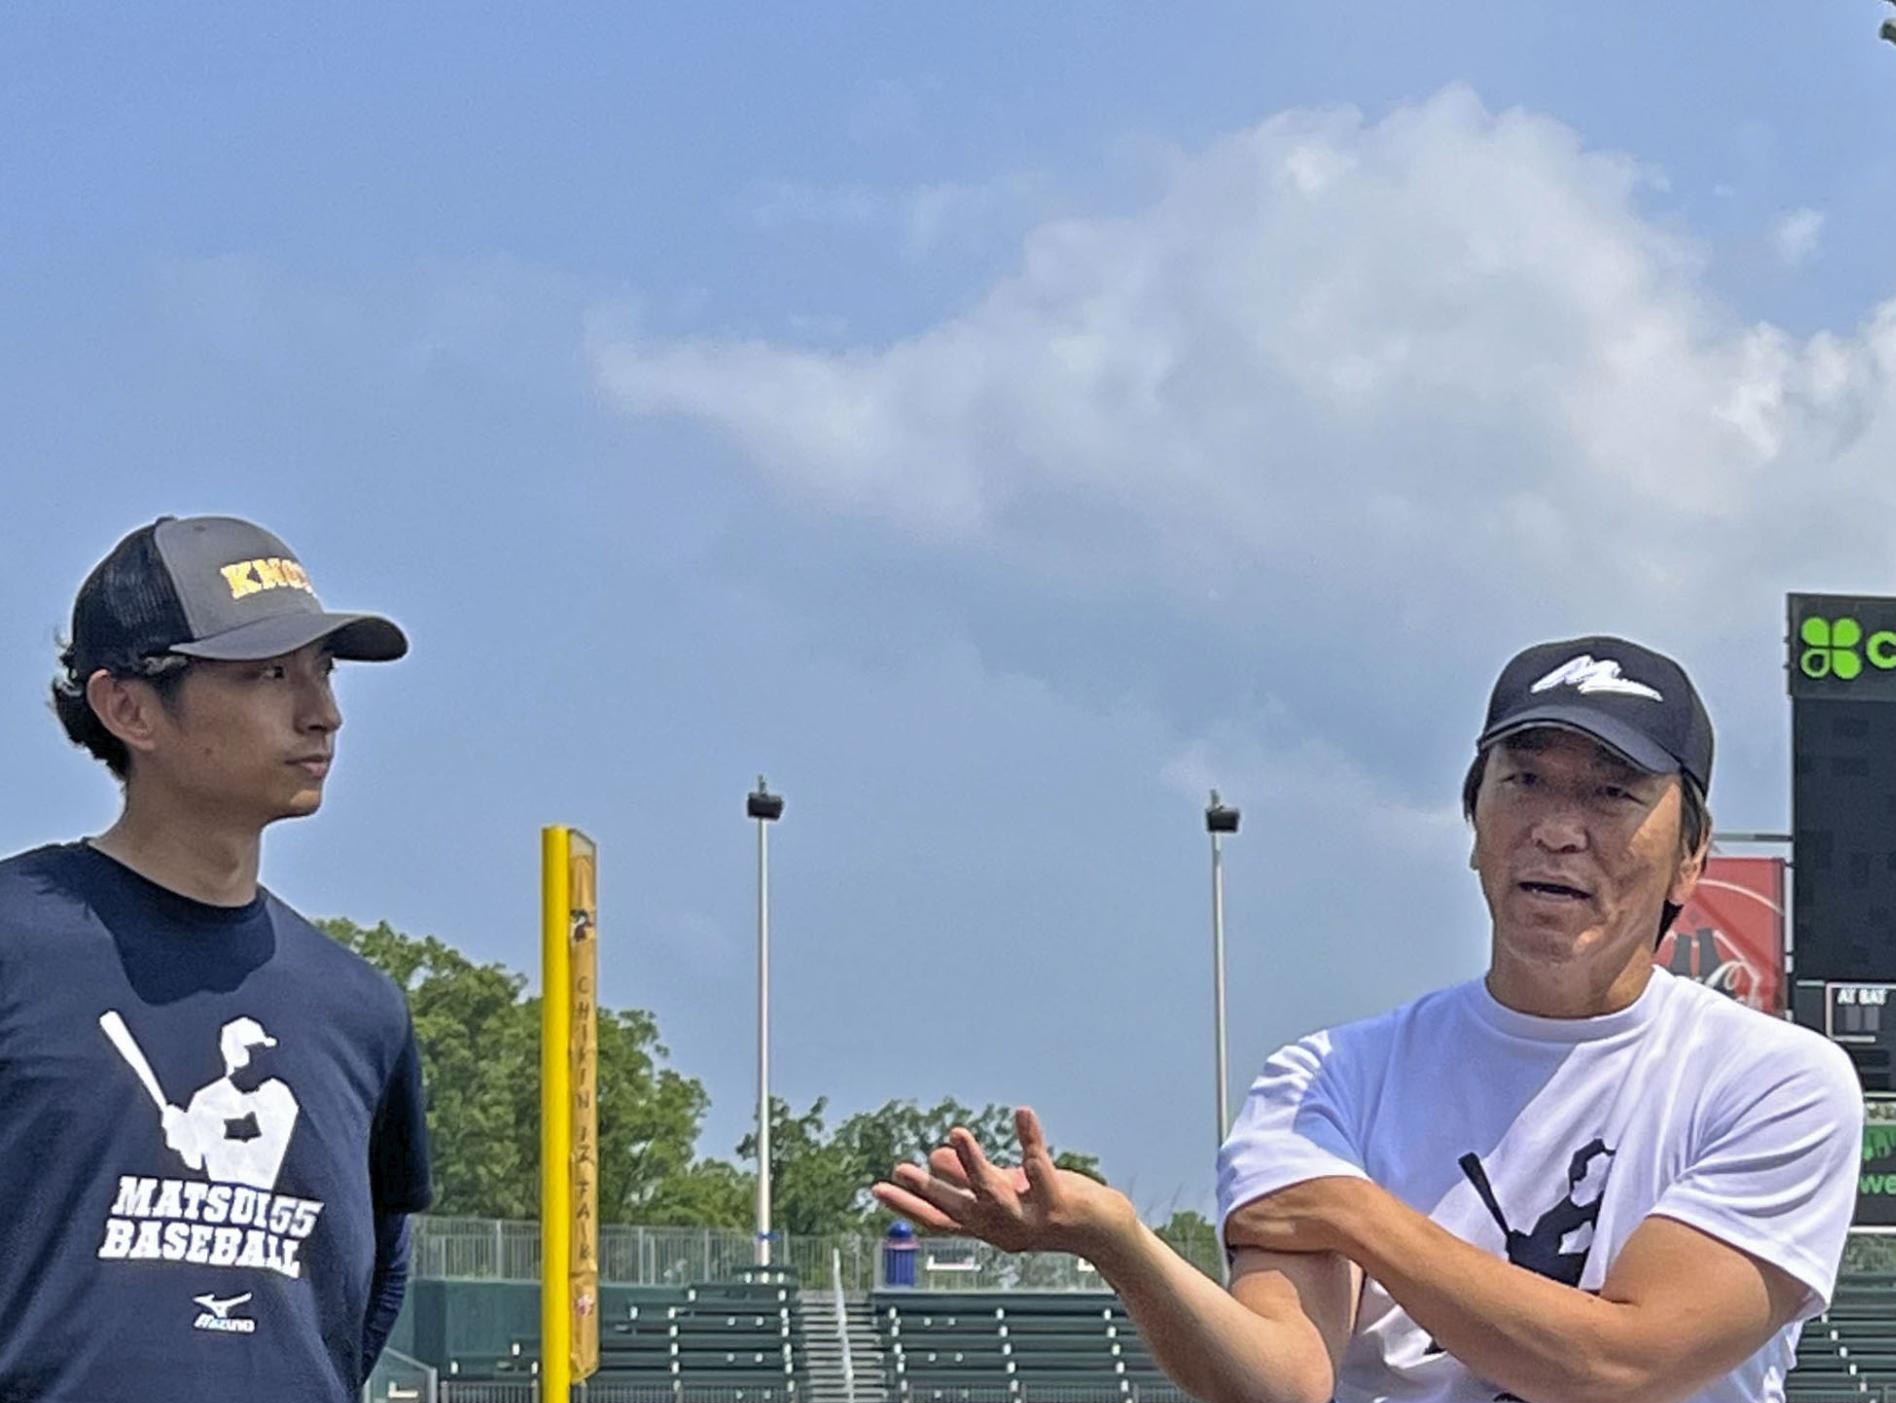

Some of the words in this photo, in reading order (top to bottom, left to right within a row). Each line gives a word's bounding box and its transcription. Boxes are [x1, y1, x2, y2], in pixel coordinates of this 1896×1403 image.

[1837, 989, 1857, 1005] AT
[1858, 989, 1887, 1006] BAT
[97, 1217, 301, 1279] BASEBALL
